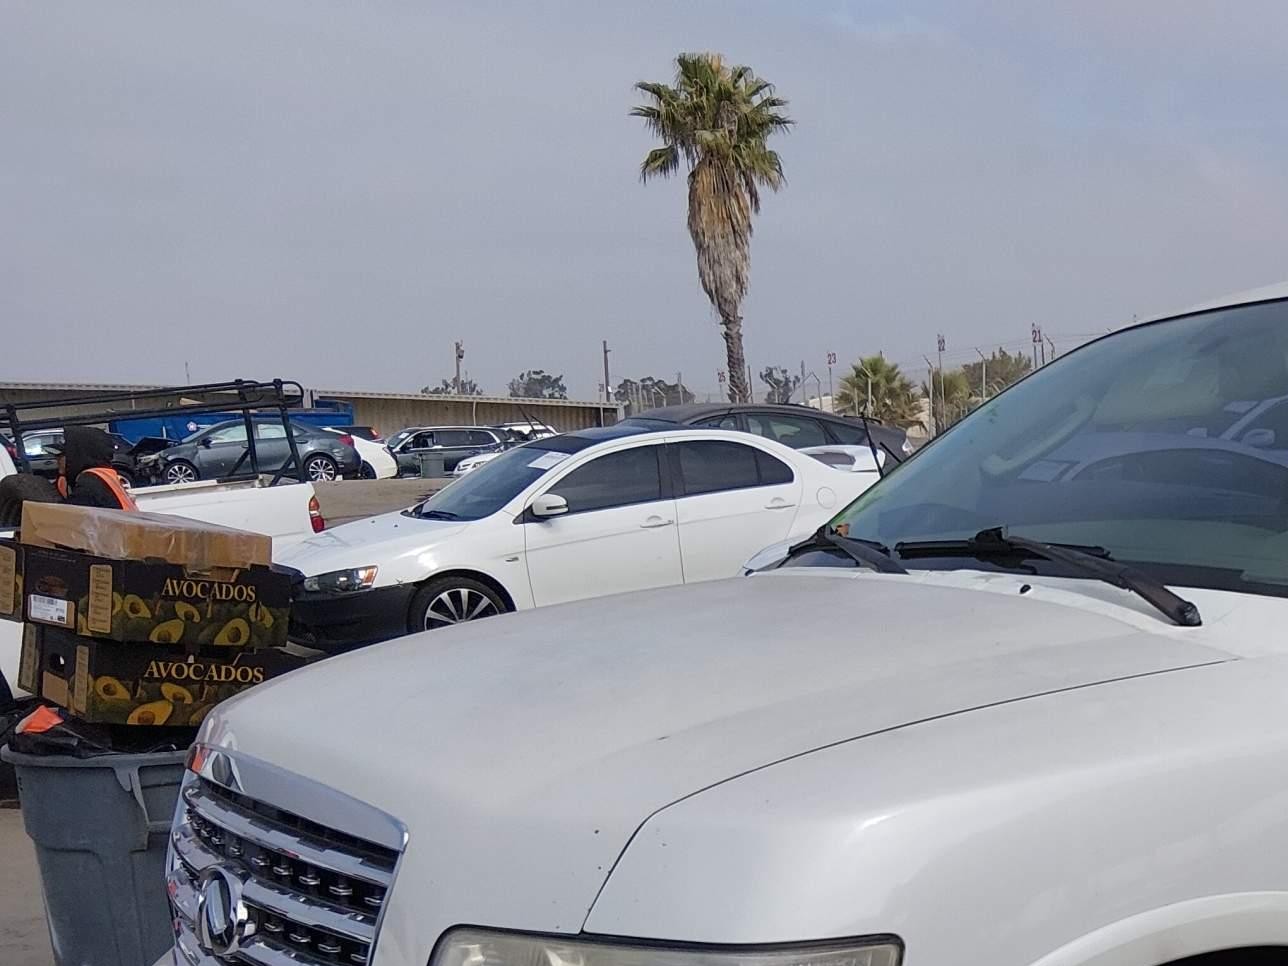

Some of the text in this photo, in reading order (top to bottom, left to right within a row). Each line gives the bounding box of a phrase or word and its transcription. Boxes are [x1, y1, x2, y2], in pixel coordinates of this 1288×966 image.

[1032, 329, 1041, 342] 21
[828, 352, 836, 364] 23
[162, 577, 256, 602] AVOCADOS
[143, 660, 264, 683] AVOCADOS
